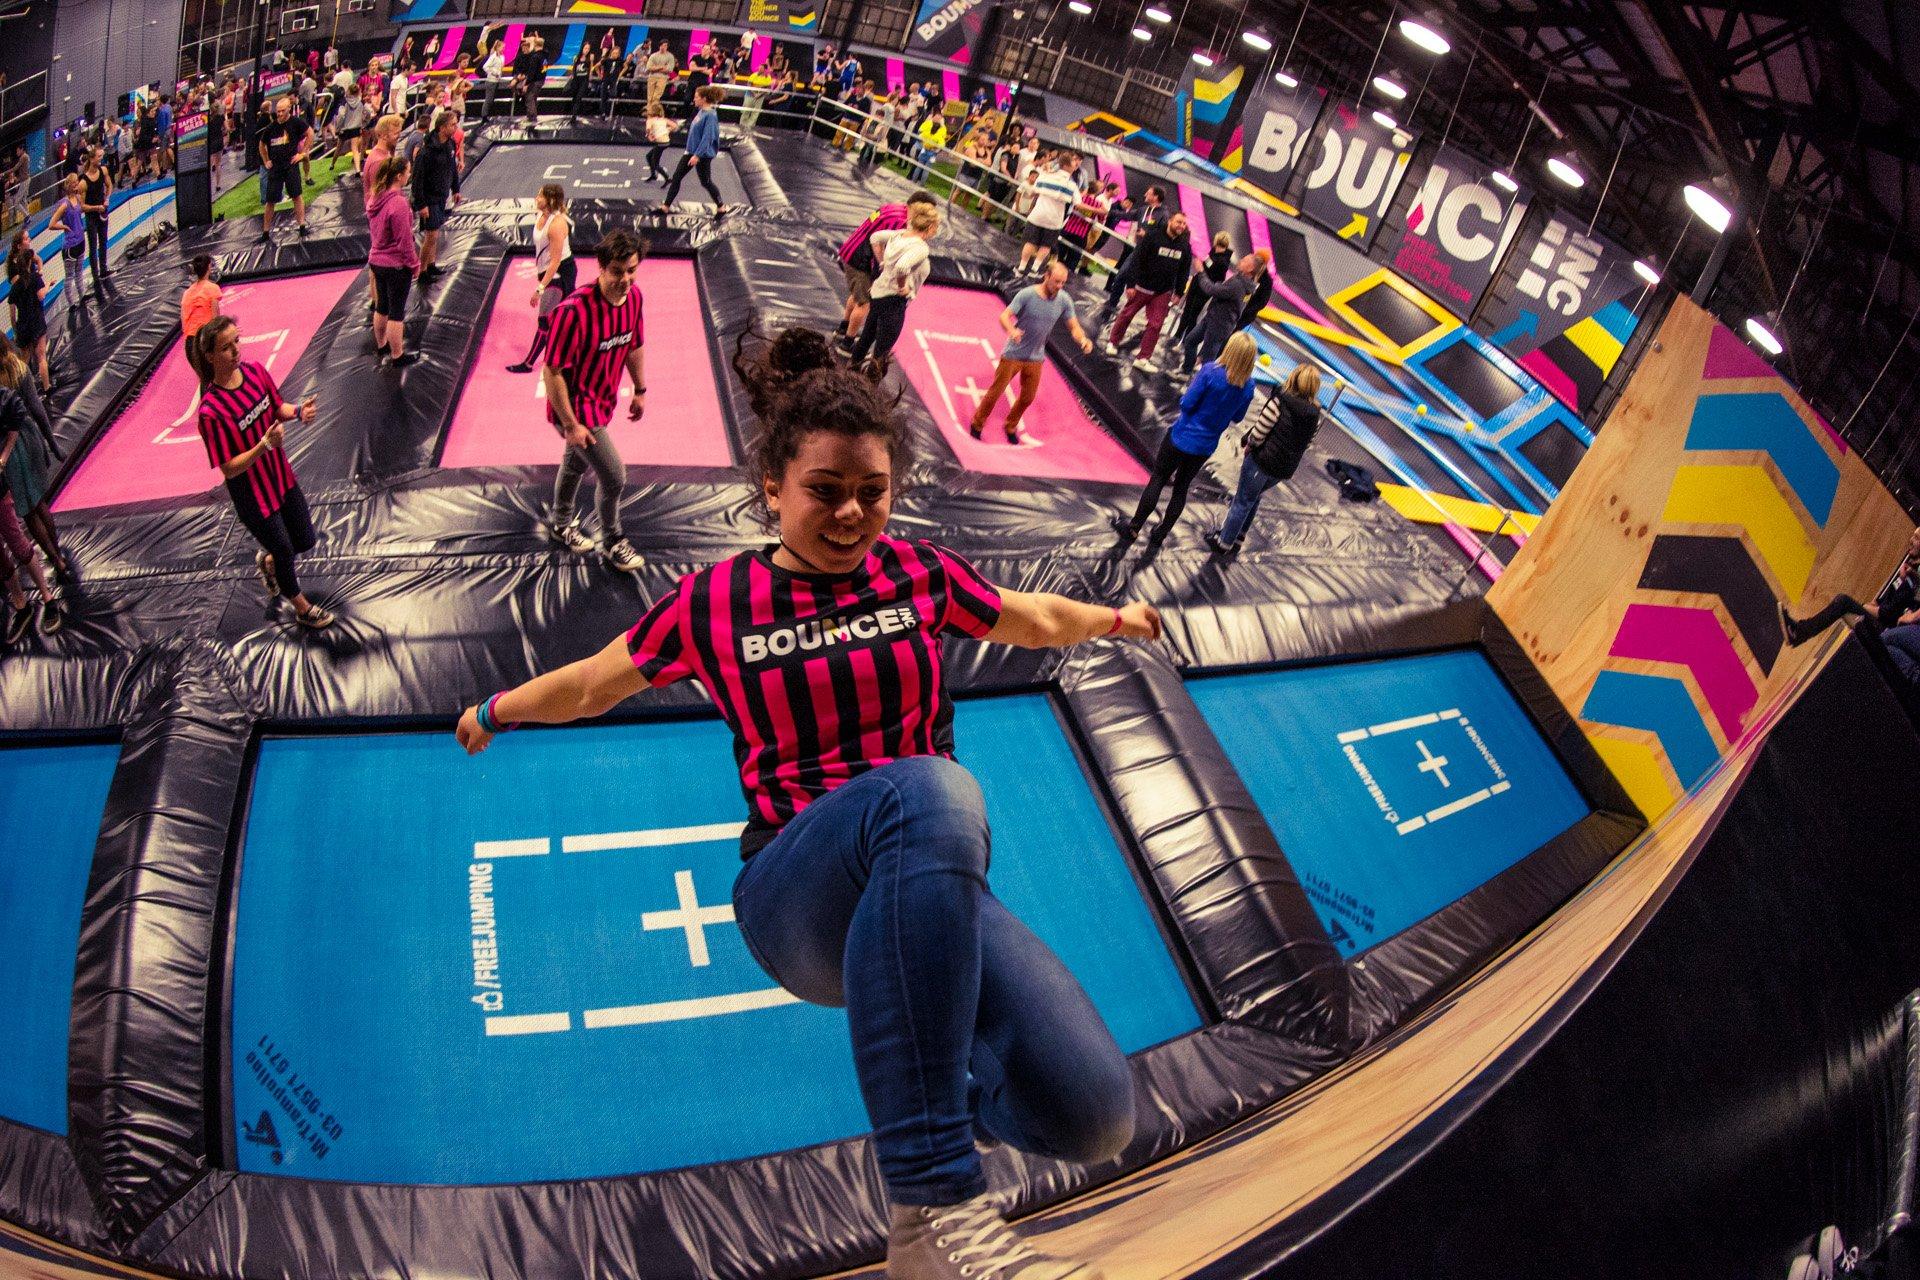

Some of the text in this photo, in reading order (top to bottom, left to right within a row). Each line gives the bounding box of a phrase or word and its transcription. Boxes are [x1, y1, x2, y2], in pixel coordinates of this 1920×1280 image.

[1249, 110, 1568, 300] BOUNCE
[1546, 231, 1604, 316] INC
[741, 608, 904, 664] BOUNCE
[898, 607, 916, 630] INC
[245, 1051, 330, 1160] MrTrampoline
